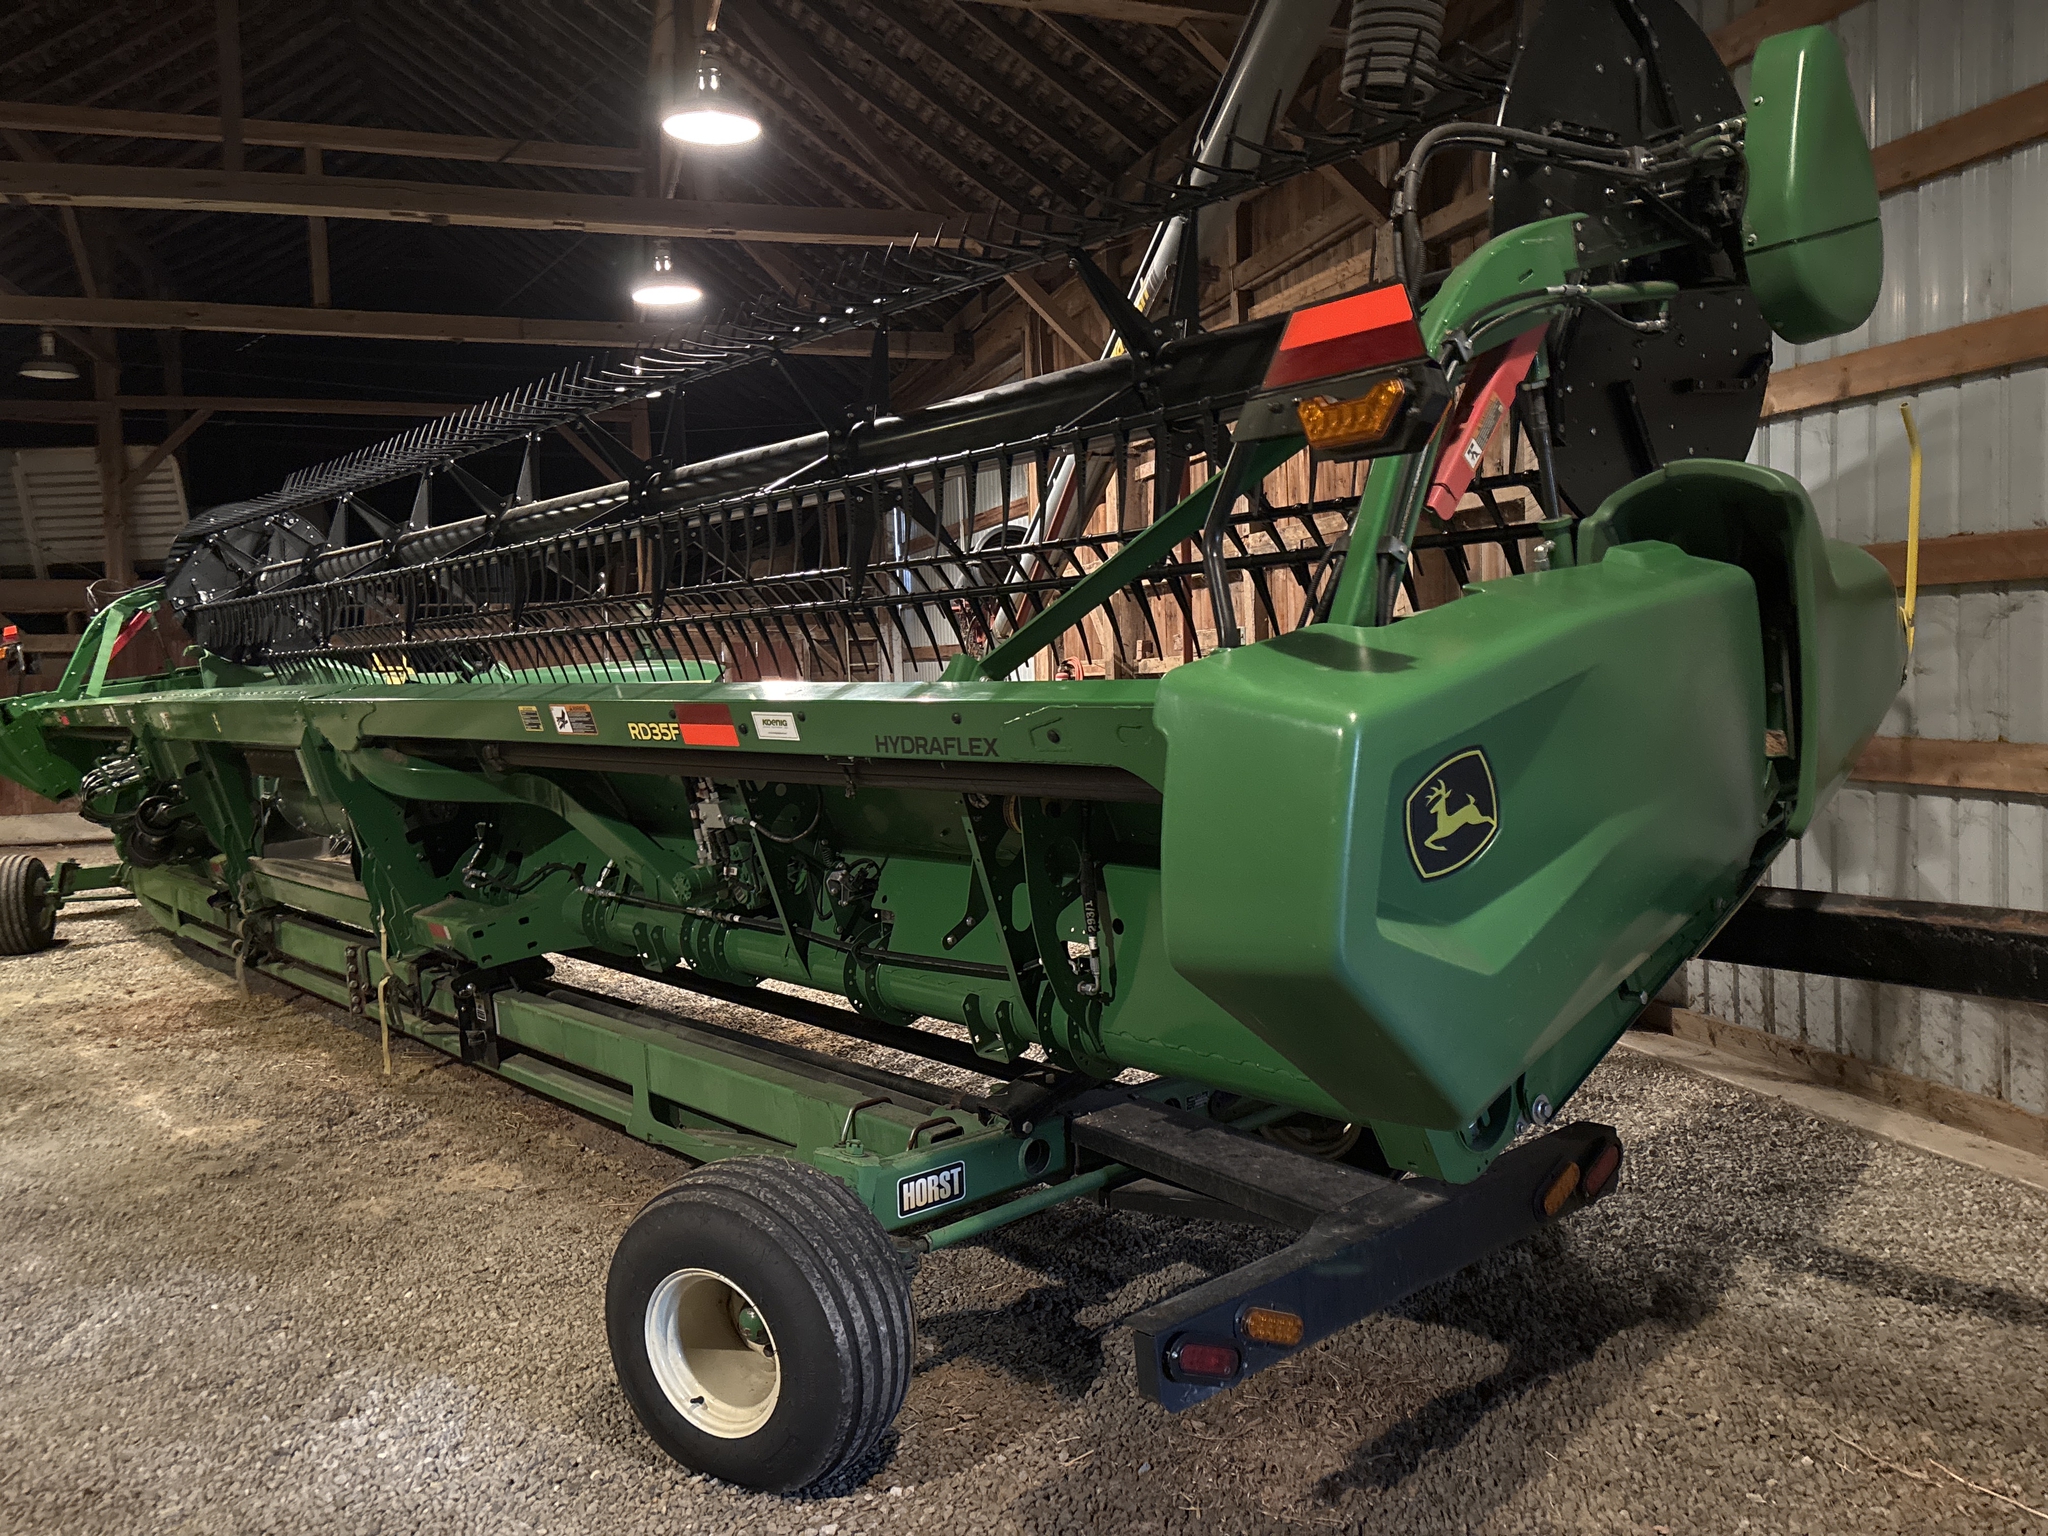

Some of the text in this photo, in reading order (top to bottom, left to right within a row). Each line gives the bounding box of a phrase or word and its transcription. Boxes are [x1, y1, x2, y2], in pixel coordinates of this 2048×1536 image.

[628, 722, 681, 741] RD35F
[874, 735, 999, 757] HYDRAFLEX
[1085, 900, 1096, 933] 293/1
[902, 1167, 962, 1211] HORST
